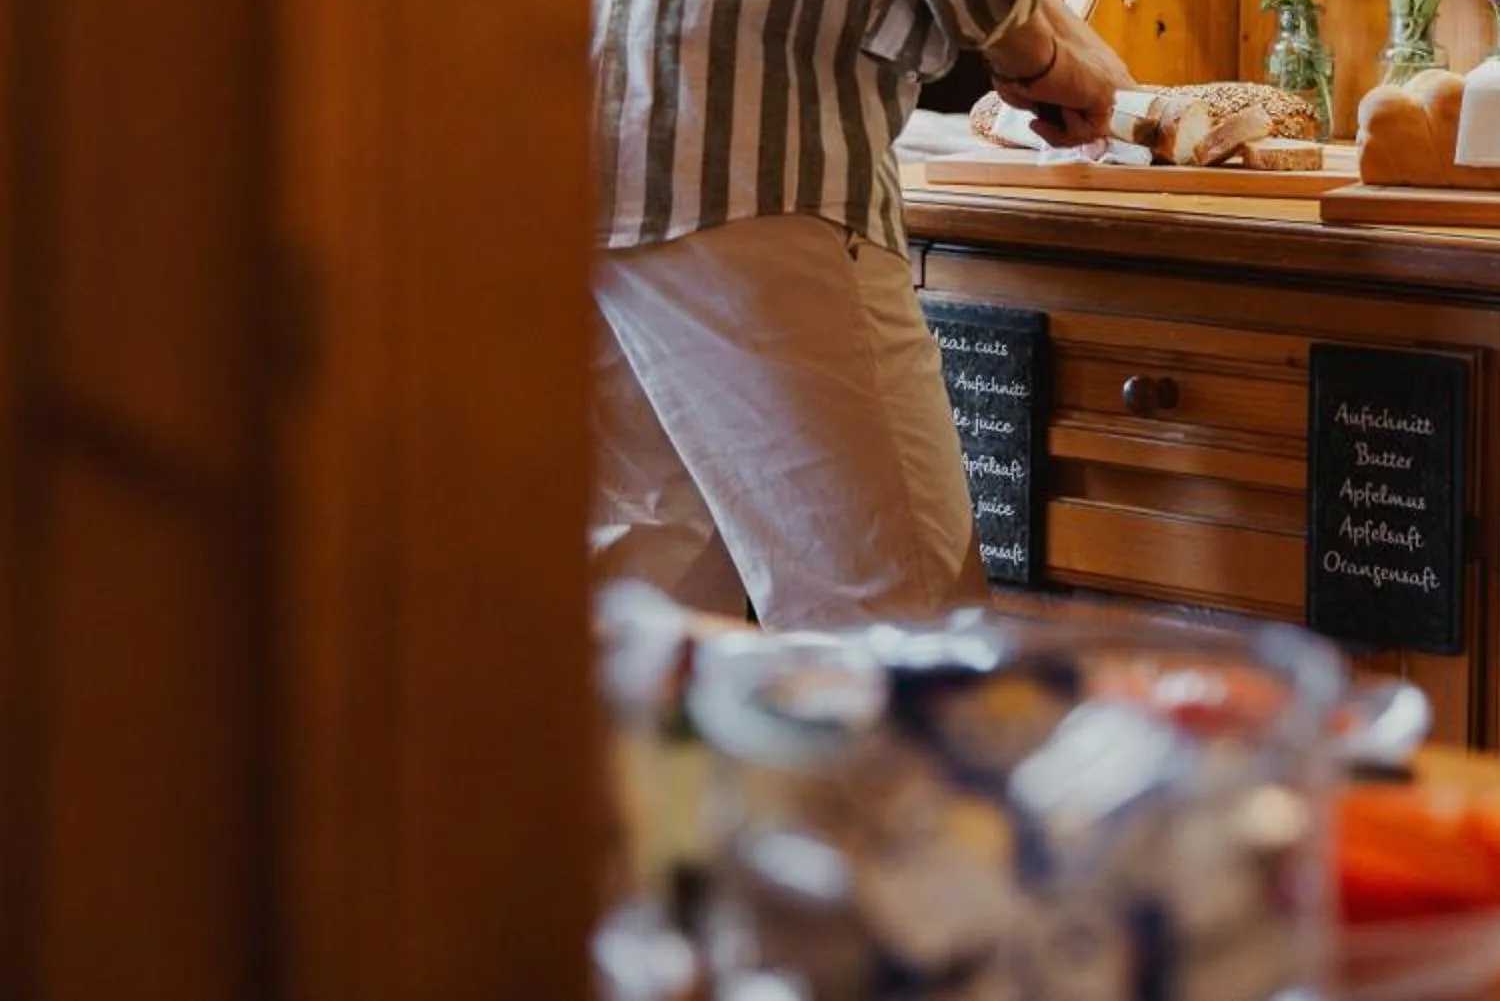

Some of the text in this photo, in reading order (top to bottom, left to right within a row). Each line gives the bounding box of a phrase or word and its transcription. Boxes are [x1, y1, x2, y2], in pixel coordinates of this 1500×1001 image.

[975, 341, 1009, 356] cuts
[954, 371, 1030, 397] Aufschnitt
[971, 412, 1015, 436] juice
[1334, 403, 1435, 435] Aufschnitt
[961, 452, 1025, 481] Apfelsaft
[1355, 442, 1412, 469] Butter
[976, 495, 1015, 518] juice
[1339, 477, 1426, 510] Apfelmus
[1339, 516, 1425, 550] Apfelsaft
[1324, 551, 1440, 592] Orangensaft
